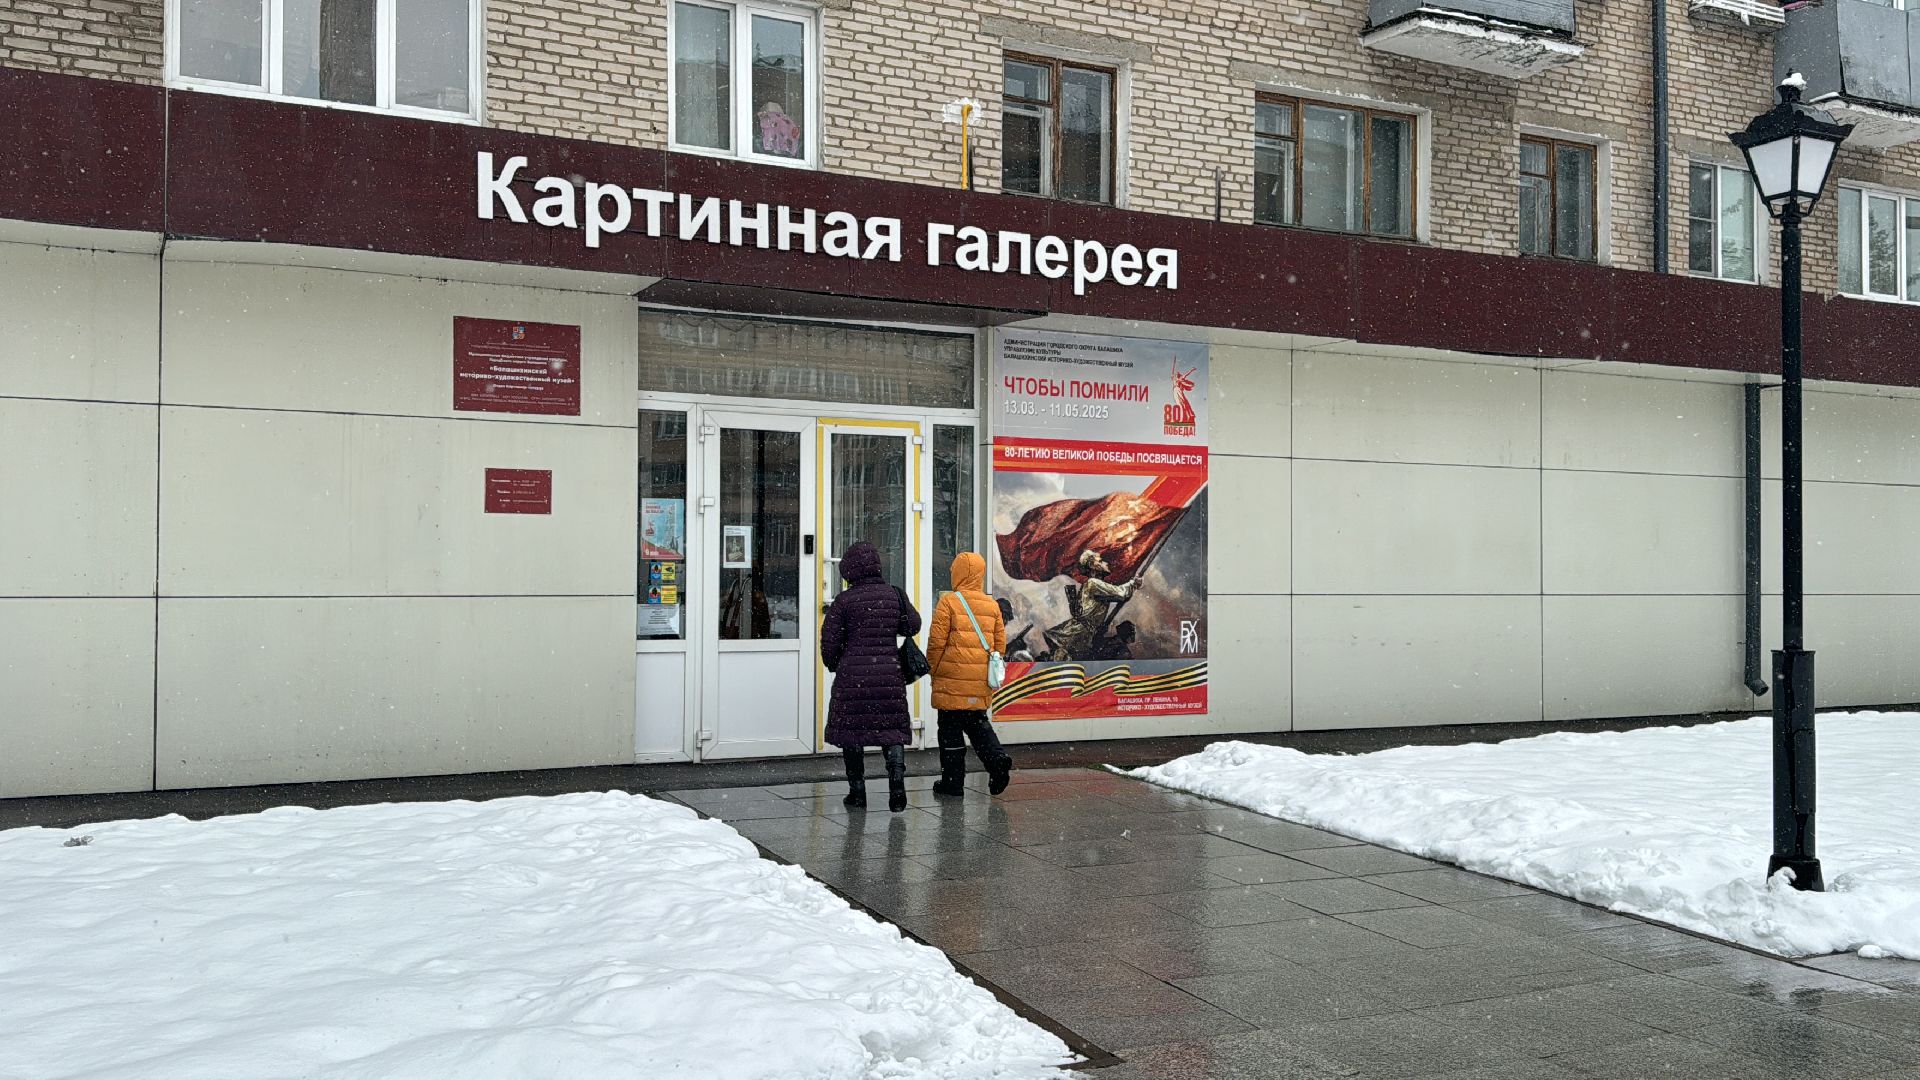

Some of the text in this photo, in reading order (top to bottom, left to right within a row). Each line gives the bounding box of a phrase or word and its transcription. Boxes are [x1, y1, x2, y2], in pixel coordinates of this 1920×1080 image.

[477, 151, 1179, 296] Картинная галерея
[1004, 375, 1149, 402] ЧТОБЫ ПОМНИЛИ
[1004, 400, 1038, 416] 13.03.
[1049, 403, 1110, 419] 11.05.2025
[1164, 404, 1181, 422] 80
[1164, 426, 1196, 436] ПОБЕДА!
[1004, 446, 1203, 466] 80-ЛЕТИЮ ВЕЛИКОЙ ПОБЕДЫ ПОСВЯЩАЕТСЯ
